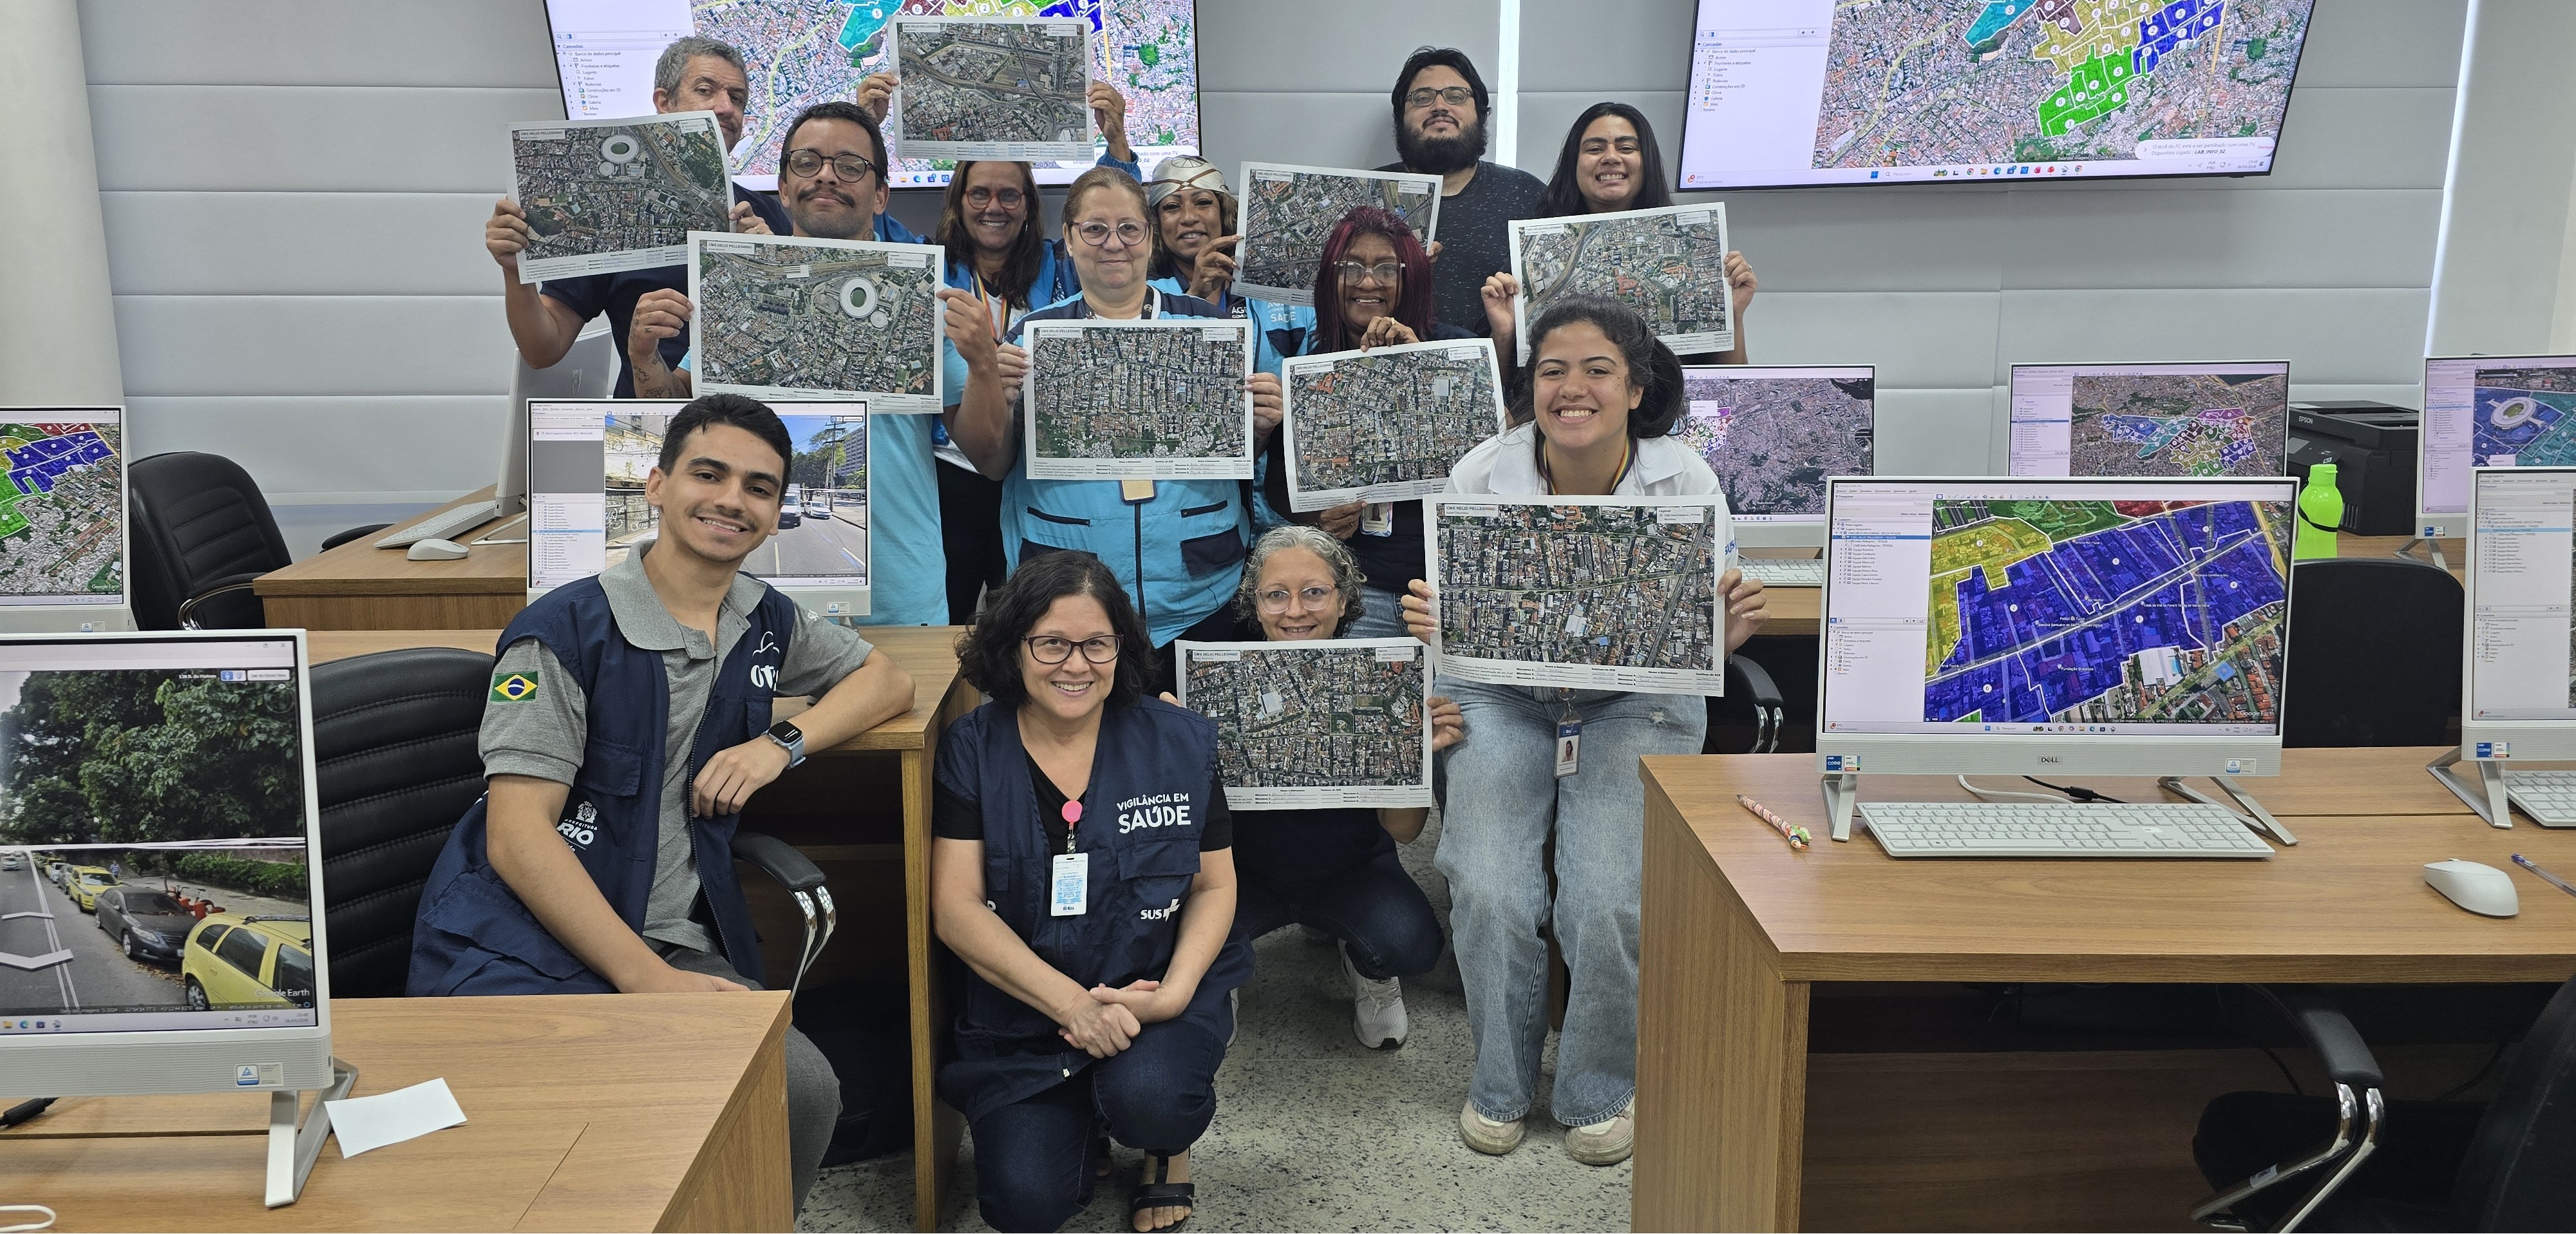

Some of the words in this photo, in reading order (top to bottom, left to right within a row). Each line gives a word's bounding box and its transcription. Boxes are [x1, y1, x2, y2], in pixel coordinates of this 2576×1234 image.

[2298, 415, 2313, 424] EPSON
[1117, 794, 1171, 812] VIGILÂNCIA
[1173, 793, 1189, 802] EM
[565, 819, 598, 831] PREFEITURA
[1118, 806, 1191, 834] SAÚDE
[556, 822, 594, 845] RIO
[1141, 909, 1162, 920] SUS
[255, 989, 287, 998] Google
